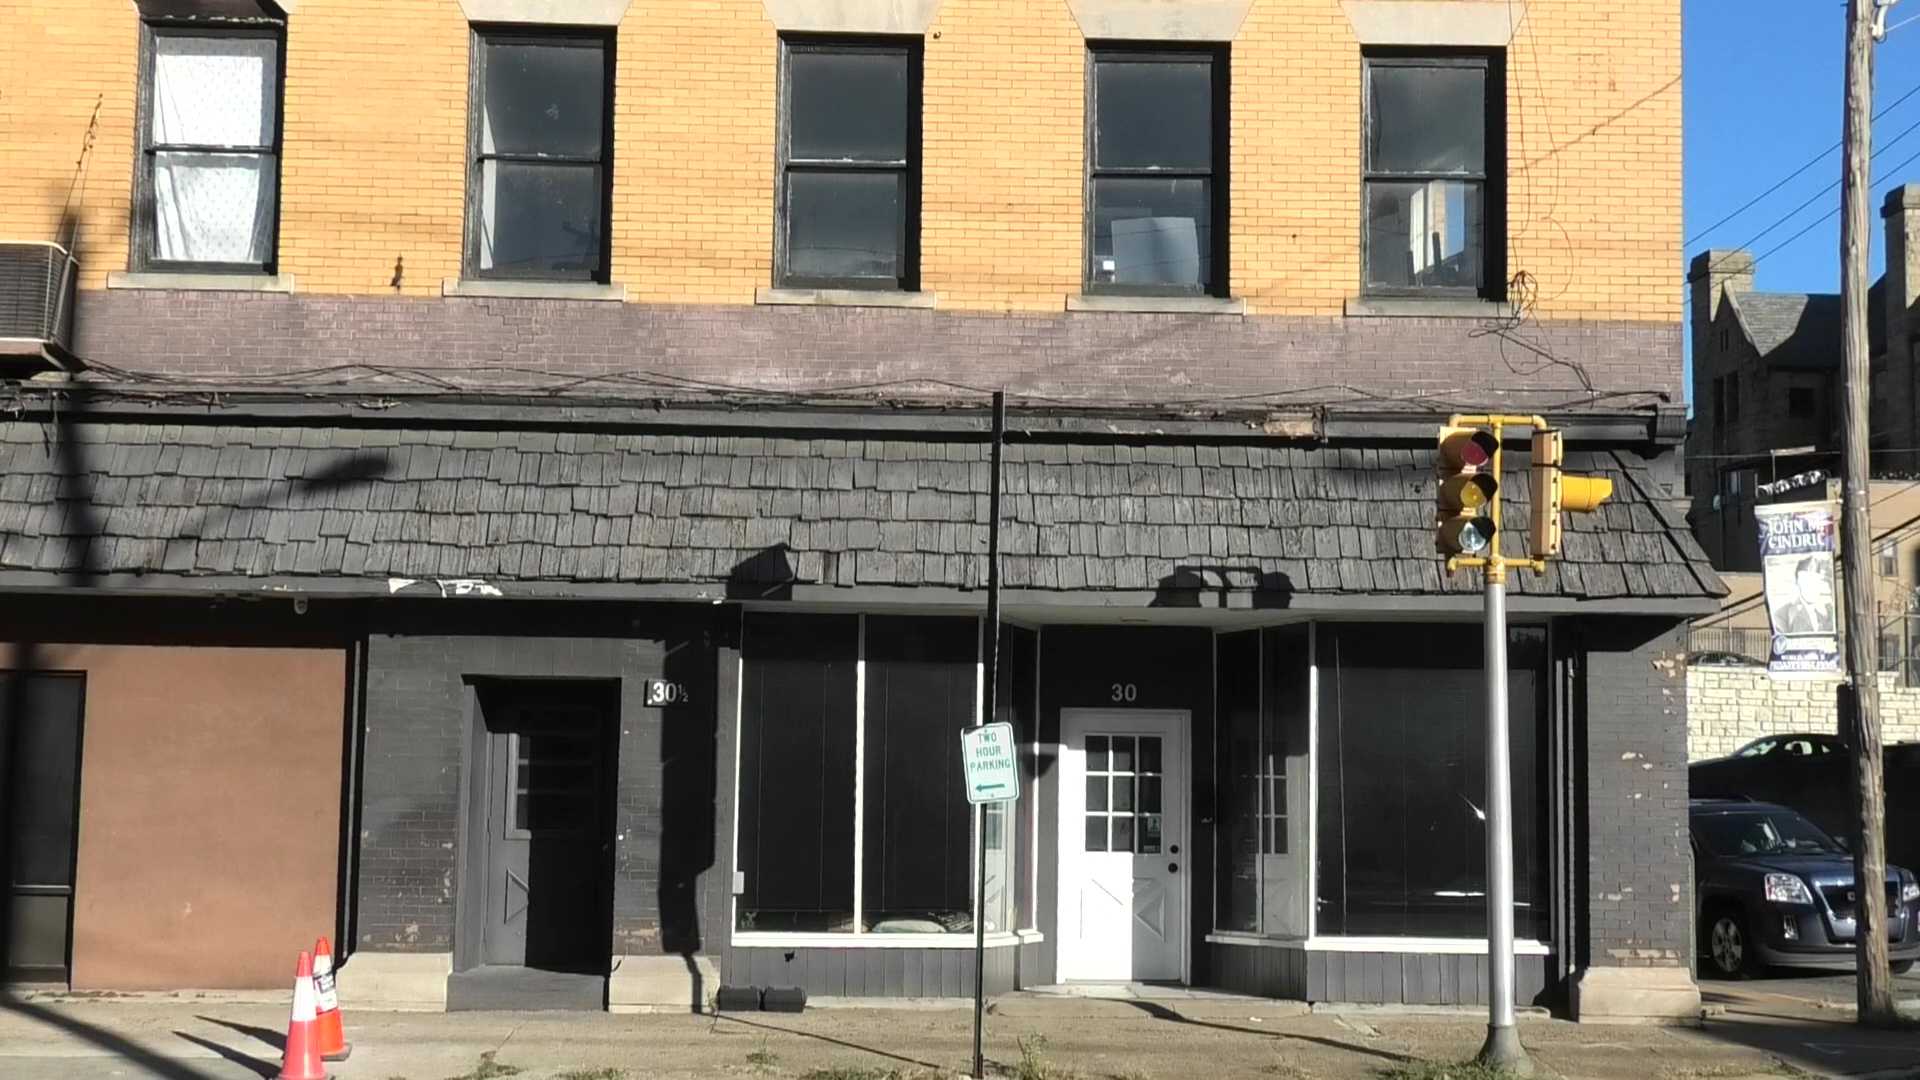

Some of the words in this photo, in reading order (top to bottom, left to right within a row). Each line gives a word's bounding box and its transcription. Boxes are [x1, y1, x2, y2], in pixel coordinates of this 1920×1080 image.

[1766, 517, 1804, 536] JOHN
[1111, 683, 1137, 702] 30
[977, 731, 997, 745] TWO
[975, 745, 1002, 758] HOUR
[970, 758, 1011, 773] PARKING
